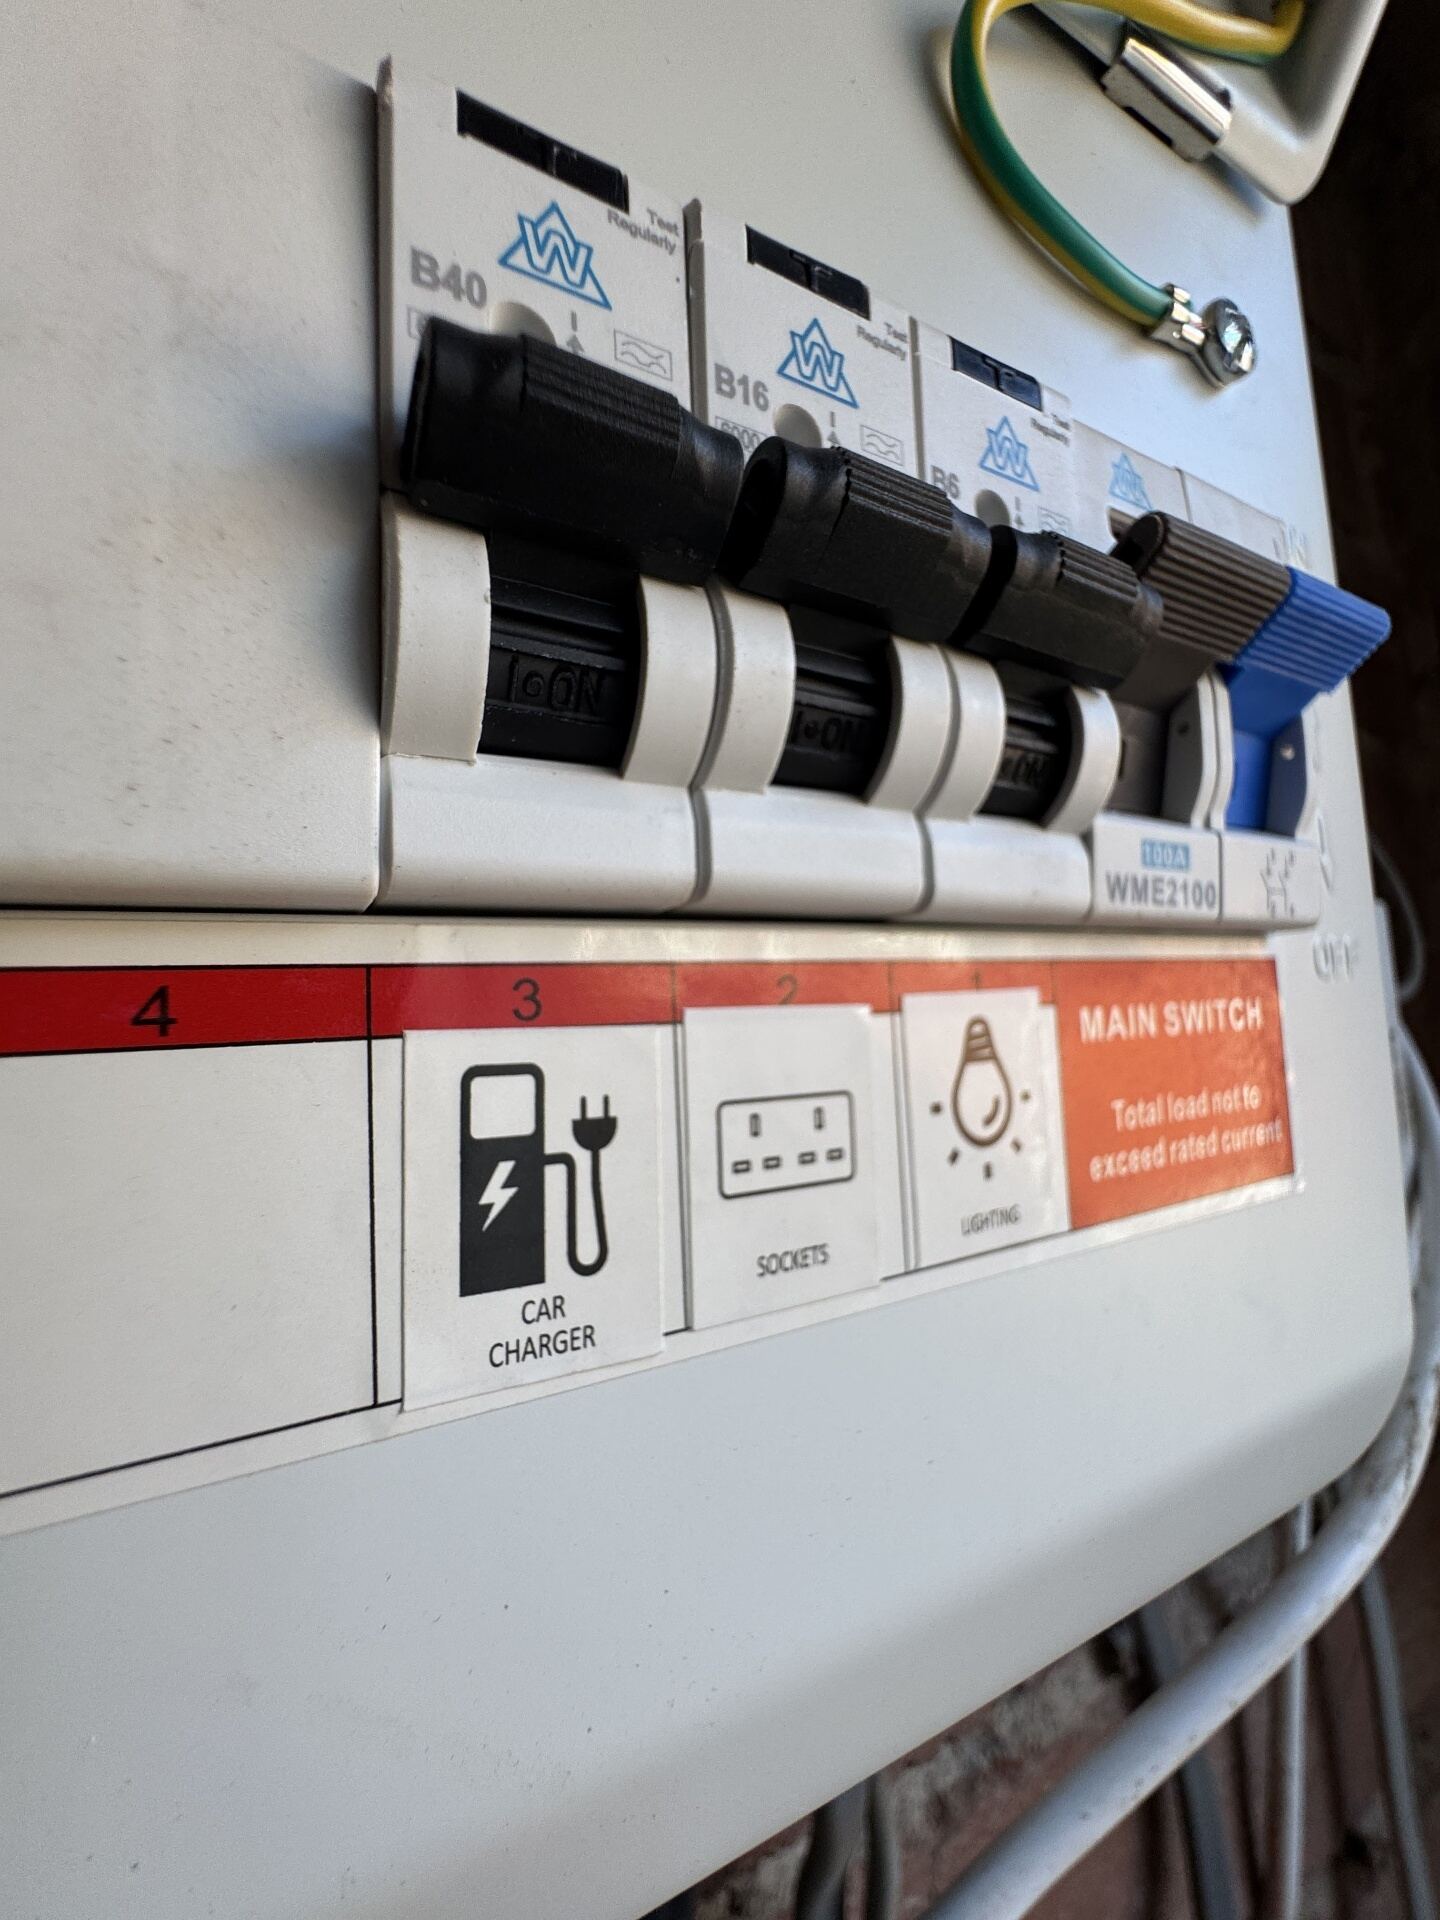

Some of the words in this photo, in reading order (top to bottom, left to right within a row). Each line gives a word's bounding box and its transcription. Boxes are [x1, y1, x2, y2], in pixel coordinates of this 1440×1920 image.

[607, 208, 677, 256] Regularly
[647, 207, 680, 237] Test
[410, 246, 488, 310] B40
[714, 362, 770, 412] B16
[931, 464, 960, 500] B6
[1105, 870, 1217, 910] WME2100
[131, 985, 177, 1037] 4
[511, 977, 543, 1021] 3
[776, 973, 798, 1005] 2
[1079, 1002, 1158, 1043] MAIN
[1163, 996, 1264, 1037] SWITCH
[1111, 1092, 1163, 1132] Total
[1166, 1086, 1209, 1124] load
[1212, 1083, 1241, 1116] not
[1242, 1080, 1262, 1111] to
[1089, 1135, 1166, 1183] exceed
[1169, 1126, 1217, 1166] rated
[1221, 1116, 1284, 1155] current
[960, 1203, 1022, 1237] LIGHTING
[756, 1243, 830, 1278] SOCKETS
[521, 1296, 567, 1325] CAR
[488, 1324, 597, 1369] CHARGER
